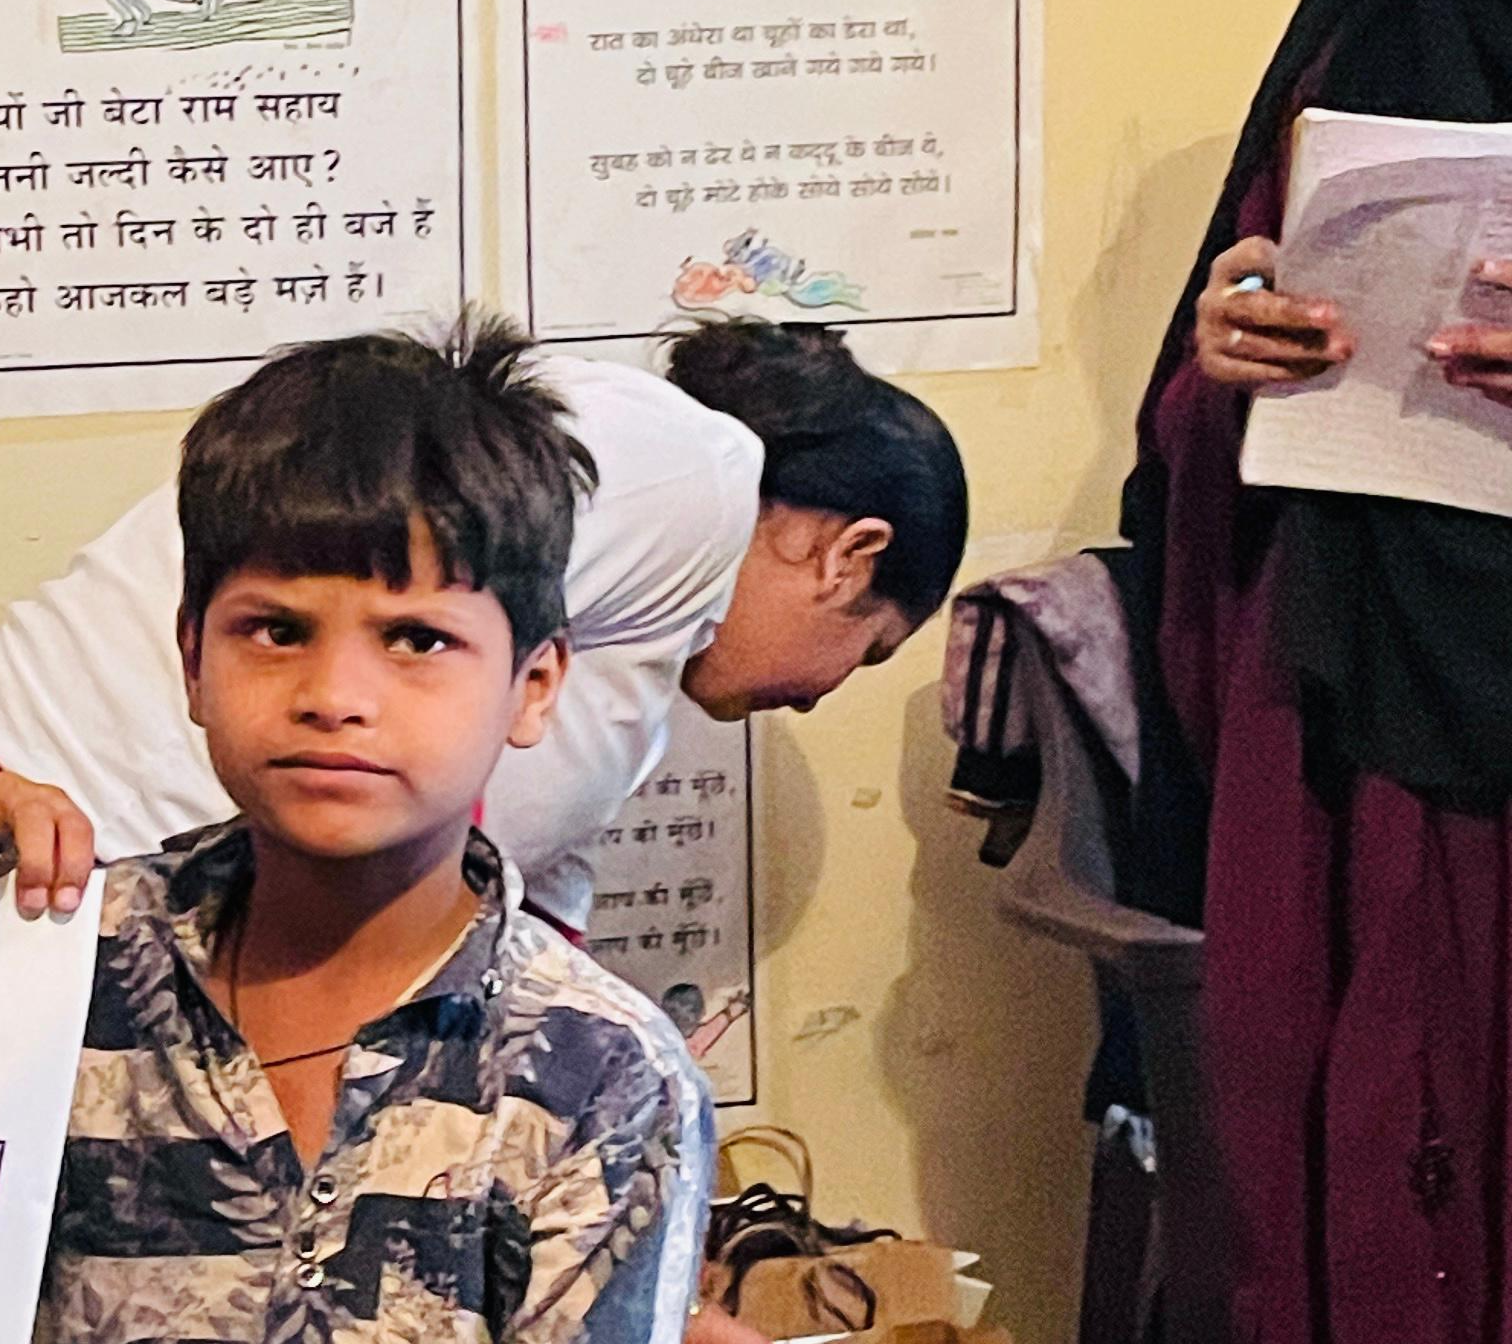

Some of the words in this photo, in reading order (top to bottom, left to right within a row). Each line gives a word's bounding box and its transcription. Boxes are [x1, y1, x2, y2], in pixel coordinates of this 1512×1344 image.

[588, 31, 625, 51] रात
[632, 30, 659, 49] का
[42, 88, 86, 129] जी
[101, 87, 164, 127] बेटा
[179, 95, 238, 122] राम
[254, 92, 341, 125] सहाय
[65, 146, 151, 190] जल्दी
[166, 144, 229, 185] कैसे
[60, 210, 98, 250] तो
[117, 209, 176, 249] दिन
[192, 205, 226, 244] के
[241, 203, 279, 243] दो
[292, 200, 328, 242] ही
[55, 280, 190, 311] आजकल
